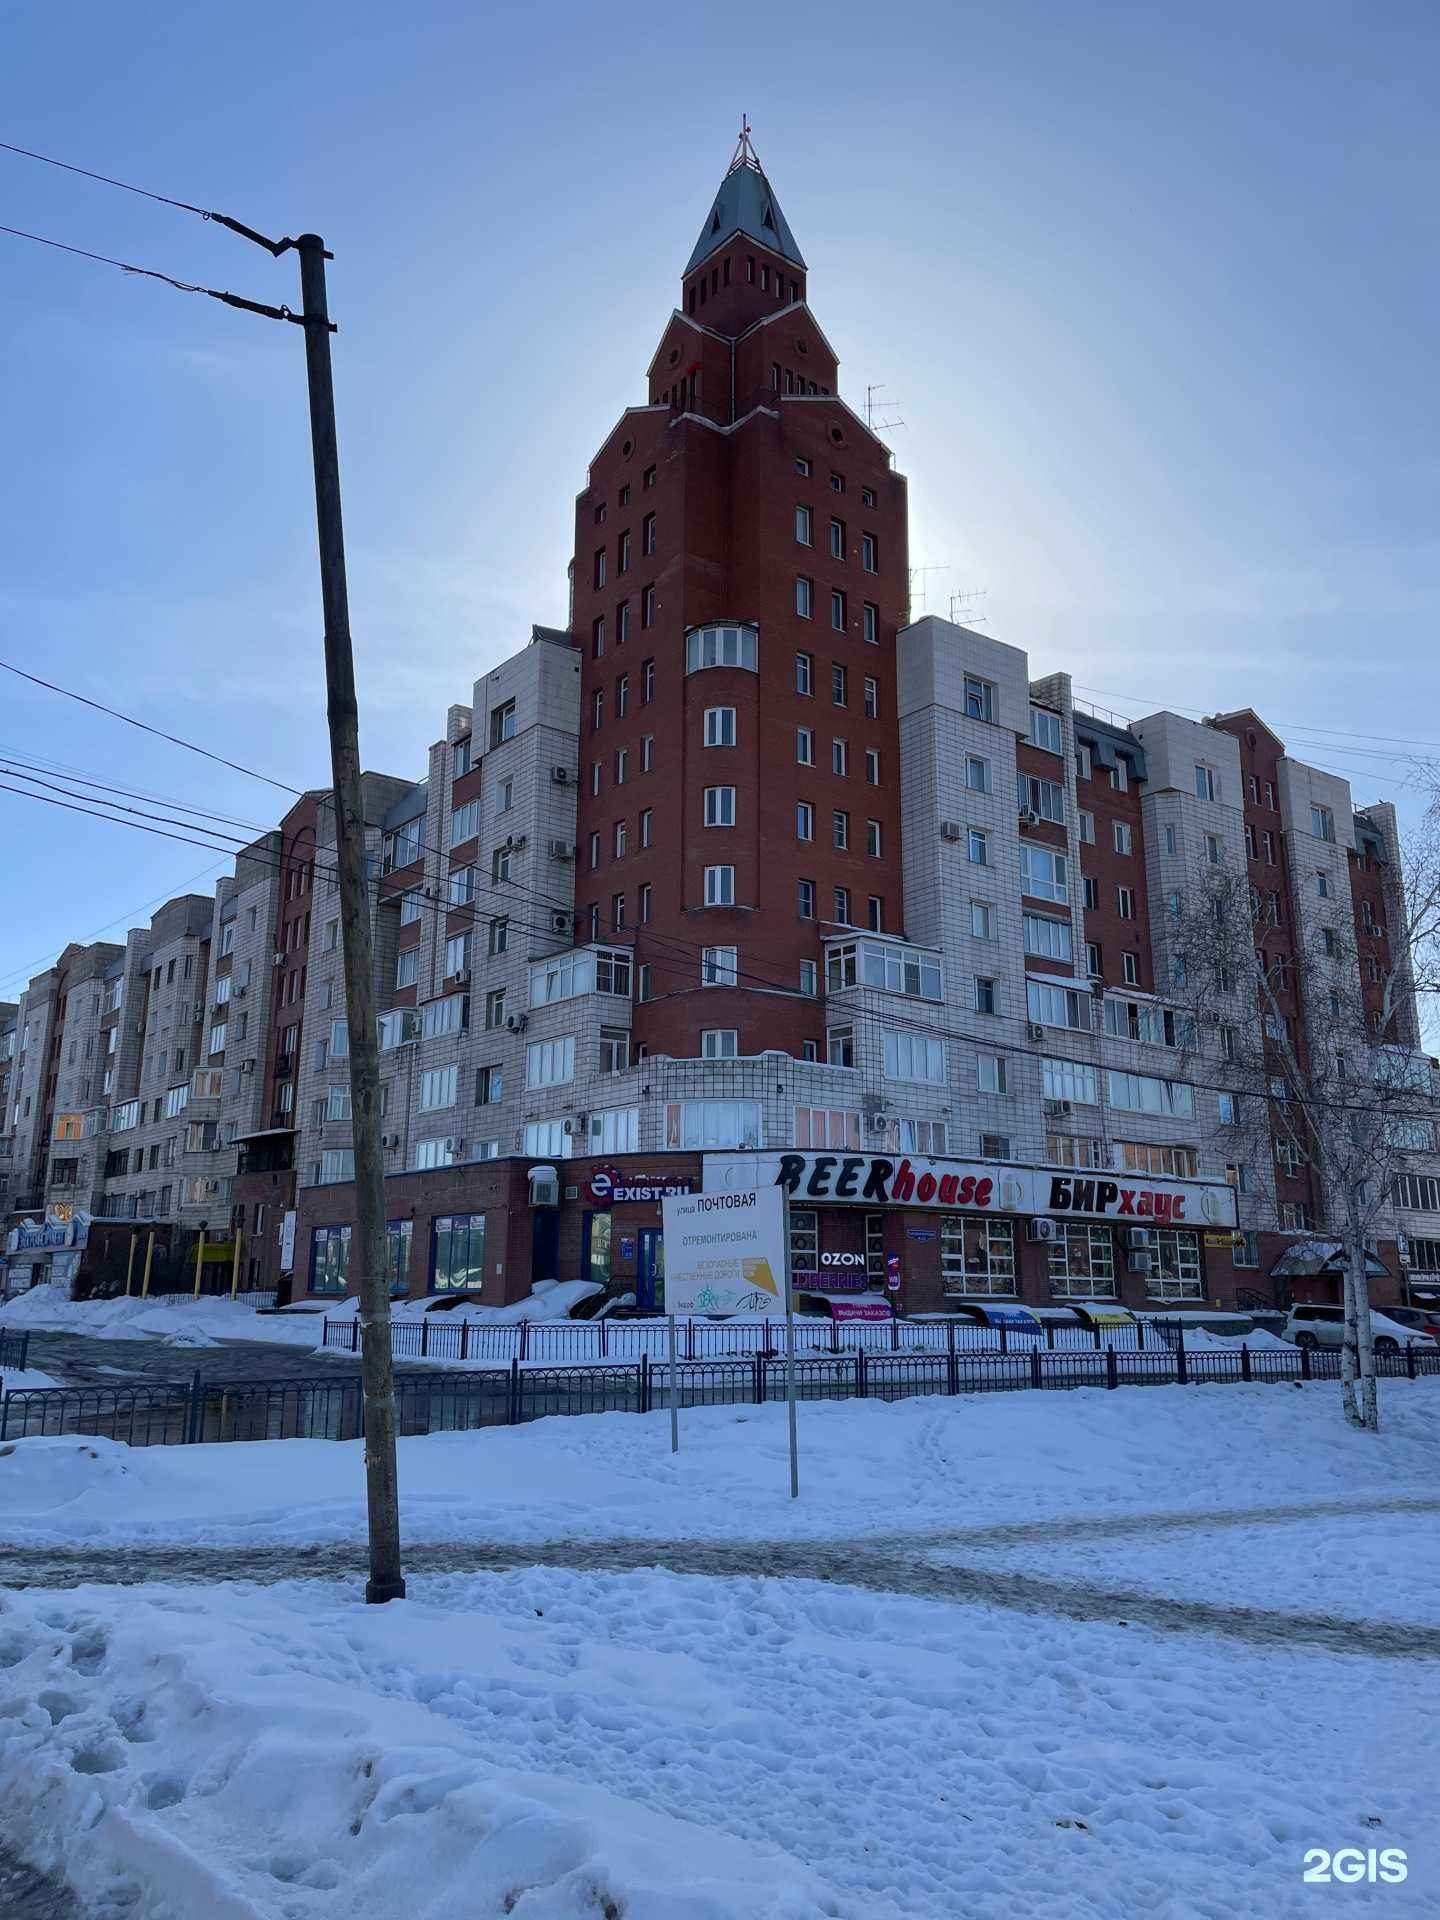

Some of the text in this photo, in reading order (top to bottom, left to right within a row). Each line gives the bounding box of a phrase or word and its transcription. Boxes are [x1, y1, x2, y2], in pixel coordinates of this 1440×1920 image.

[775, 1154, 993, 1206] BEERhouse
[676, 1192, 756, 1216] улица ПОЧТОВАЯ
[1050, 1176, 1185, 1226] БИРхаус
[681, 1229, 758, 1247] ОТРЕМОНТИРОВАНА
[821, 1252, 865, 1266] OZON
